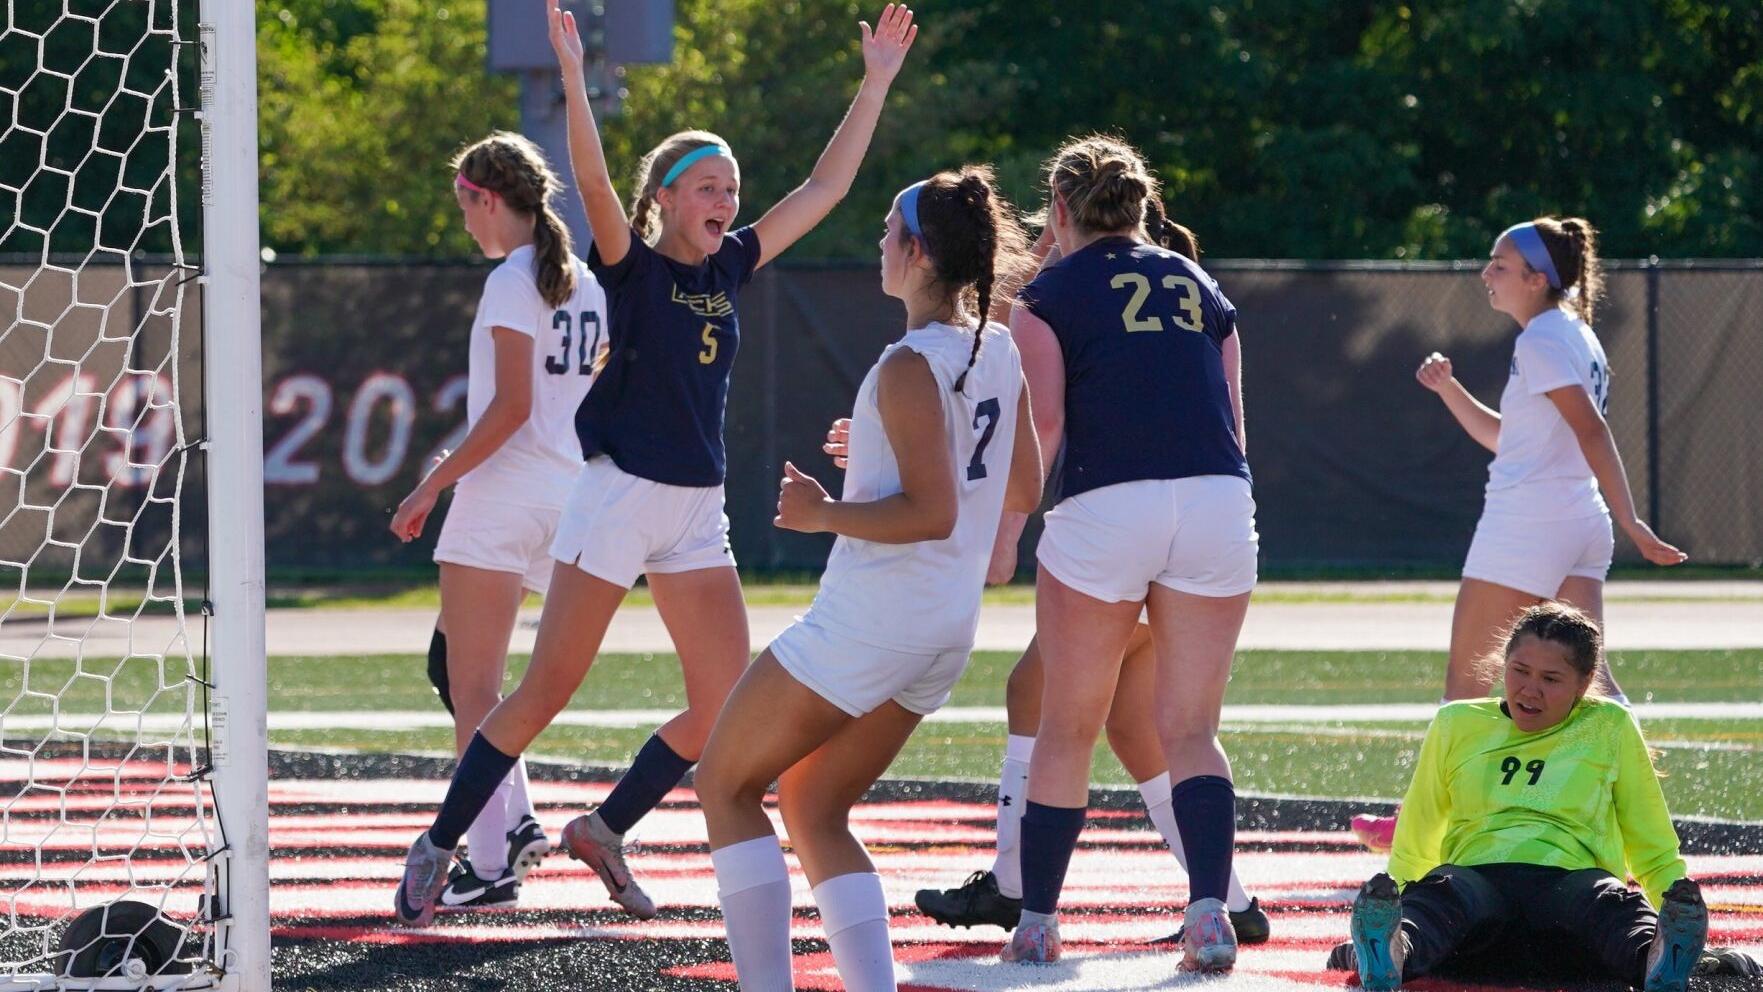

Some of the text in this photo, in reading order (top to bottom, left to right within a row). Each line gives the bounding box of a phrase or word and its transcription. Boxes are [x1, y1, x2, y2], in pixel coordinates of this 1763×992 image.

[1109, 272, 1205, 333] 23
[545, 310, 601, 375] 30
[699, 322, 722, 365] 5
[966, 397, 1002, 482] 7
[1500, 756, 1546, 786] 99
